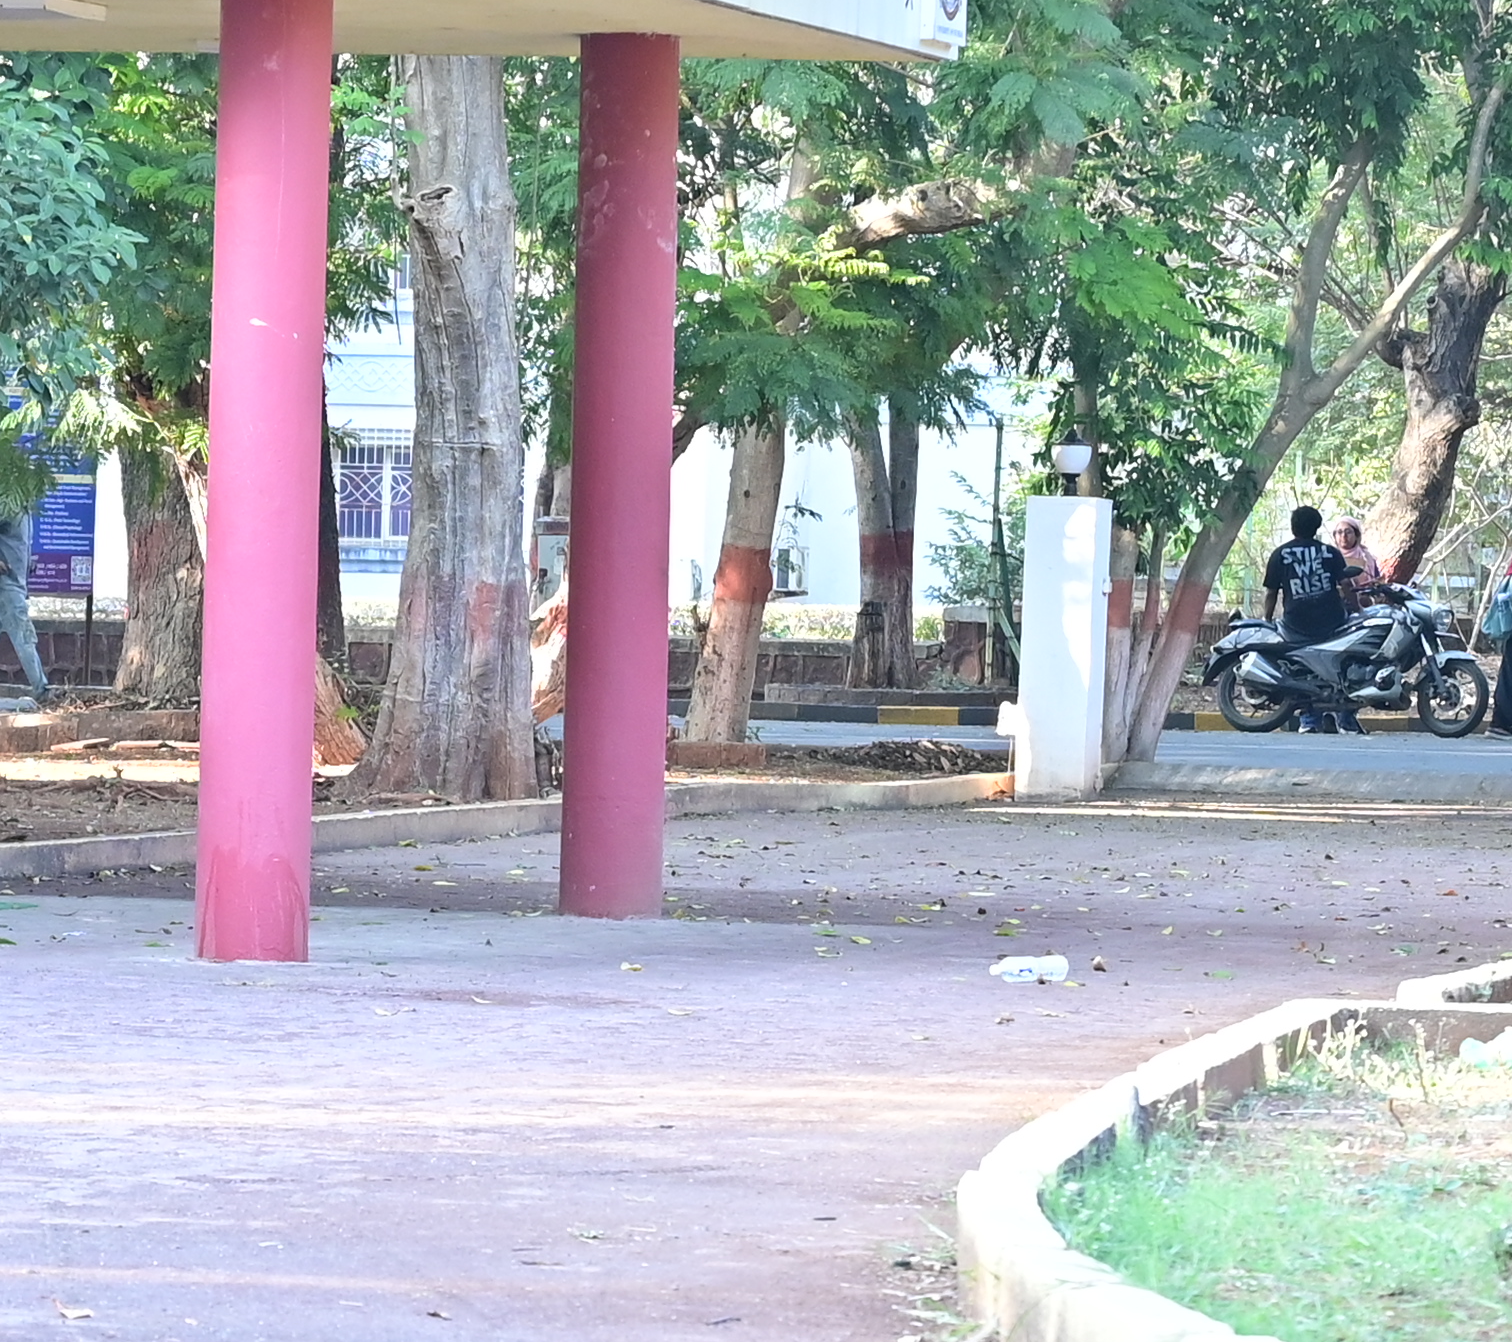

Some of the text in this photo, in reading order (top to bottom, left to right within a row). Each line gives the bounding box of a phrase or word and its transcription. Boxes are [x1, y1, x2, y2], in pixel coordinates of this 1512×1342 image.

[1281, 545, 1333, 565] STILL
[1293, 558, 1324, 578] WE
[1290, 572, 1332, 596] RISE
